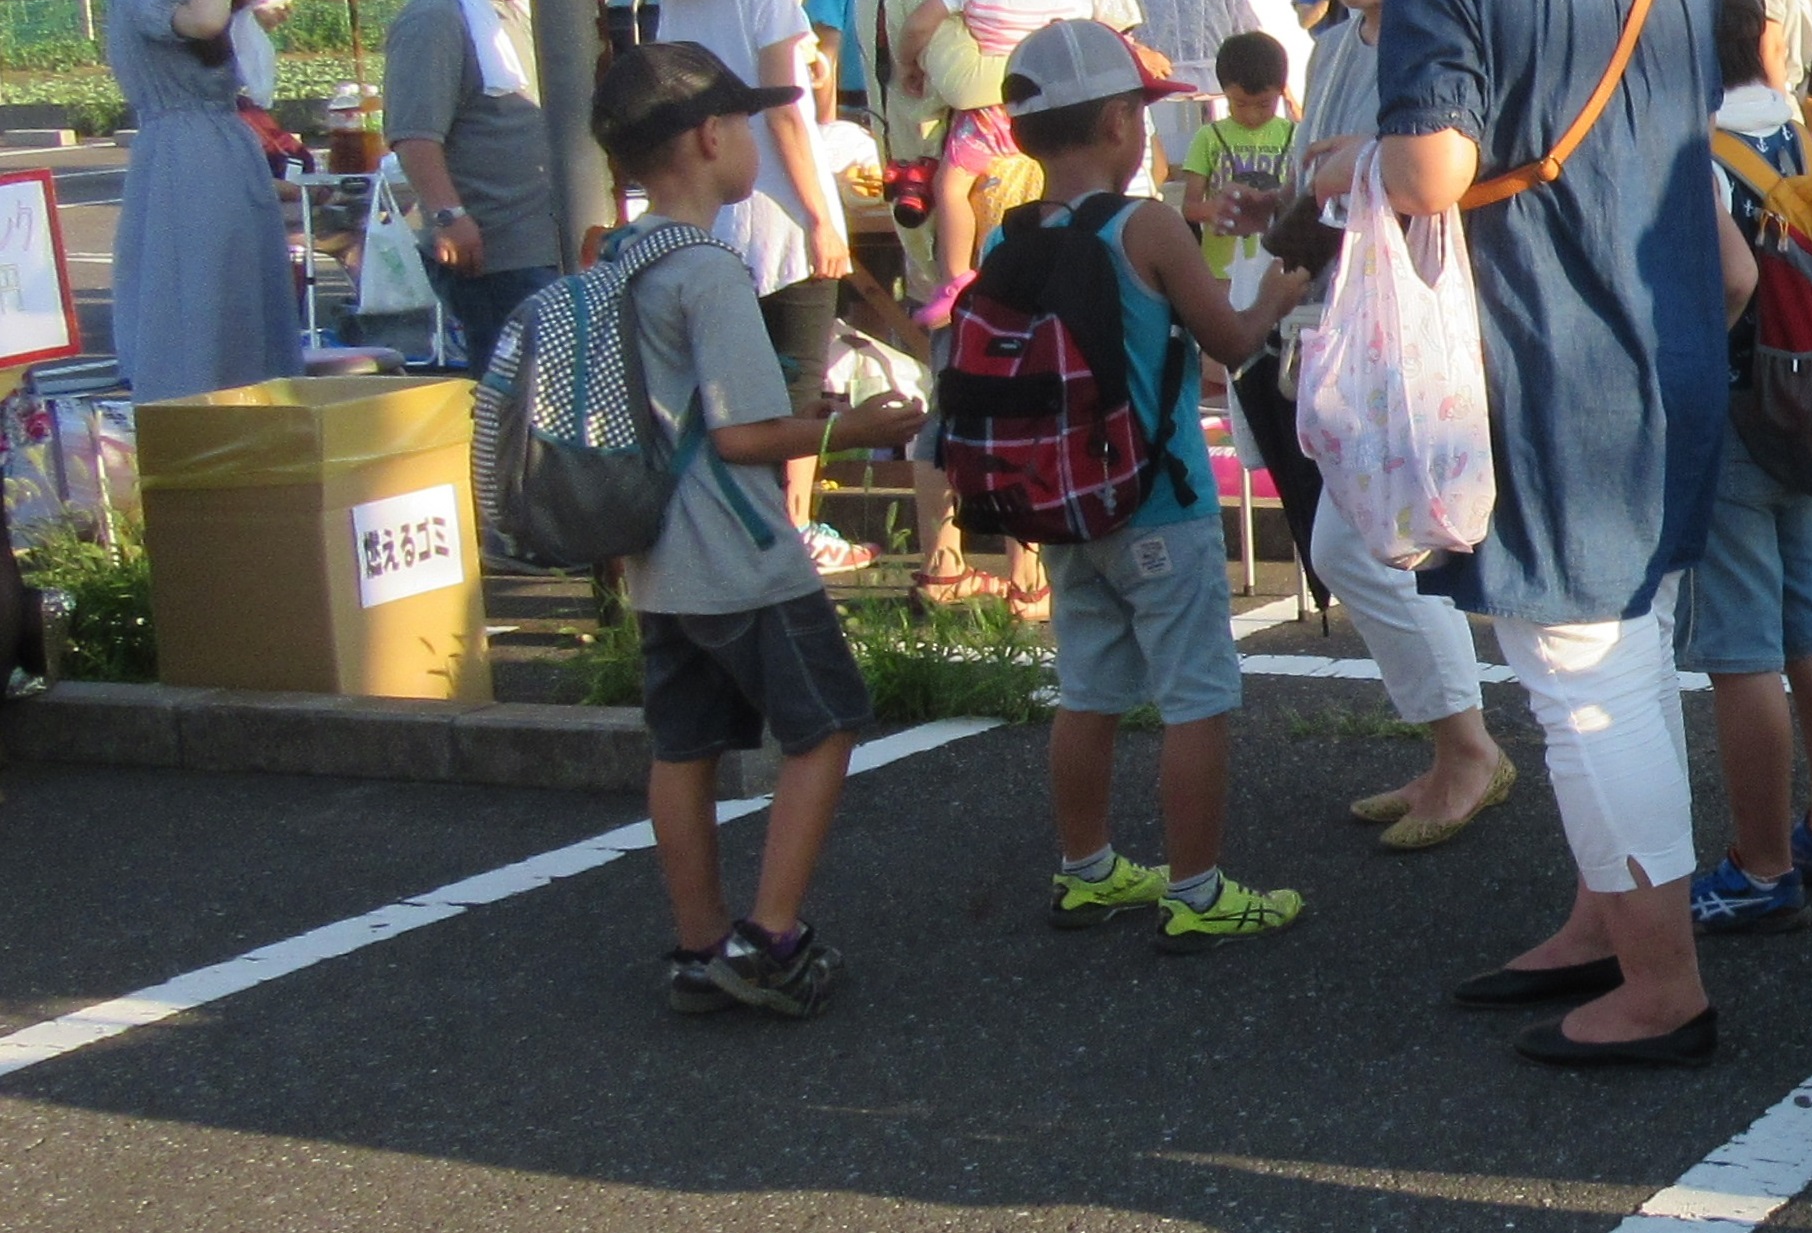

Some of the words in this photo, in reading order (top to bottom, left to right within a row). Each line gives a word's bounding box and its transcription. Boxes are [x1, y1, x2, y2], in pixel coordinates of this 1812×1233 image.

[363, 516, 450, 580] 燃えるゴミ
